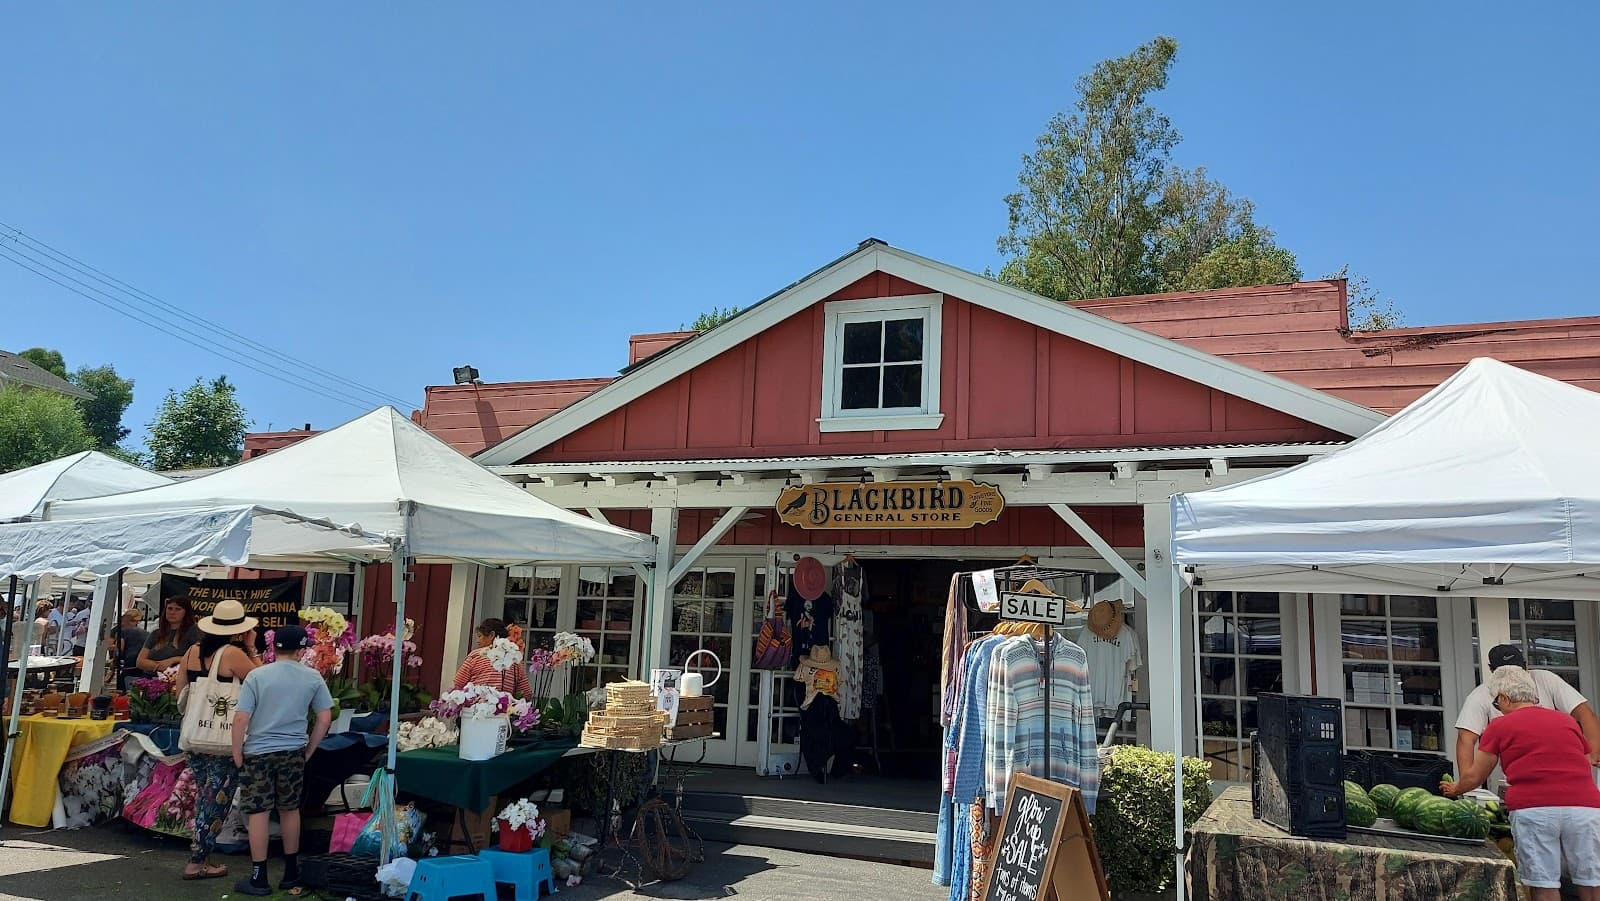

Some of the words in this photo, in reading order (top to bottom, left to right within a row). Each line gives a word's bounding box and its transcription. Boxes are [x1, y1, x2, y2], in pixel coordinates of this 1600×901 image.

[809, 487, 964, 525] BLACKBIRD
[834, 513, 905, 522] GENERAL
[911, 512, 961, 521] STORE
[188, 587, 209, 598] THE
[211, 588, 248, 600] VALLEY
[250, 588, 272, 599] HIVE
[243, 602, 297, 613] ALIFORNIA
[1007, 598, 1058, 619] SALE
[198, 719, 214, 729] BEE
[220, 720, 233, 730] KIN
[1014, 793, 1051, 836] glow
[1026, 822, 1042, 847] up
[1005, 832, 1040, 876] SALE
[1010, 870, 1022, 893] of
[1018, 875, 1038, 901] items
